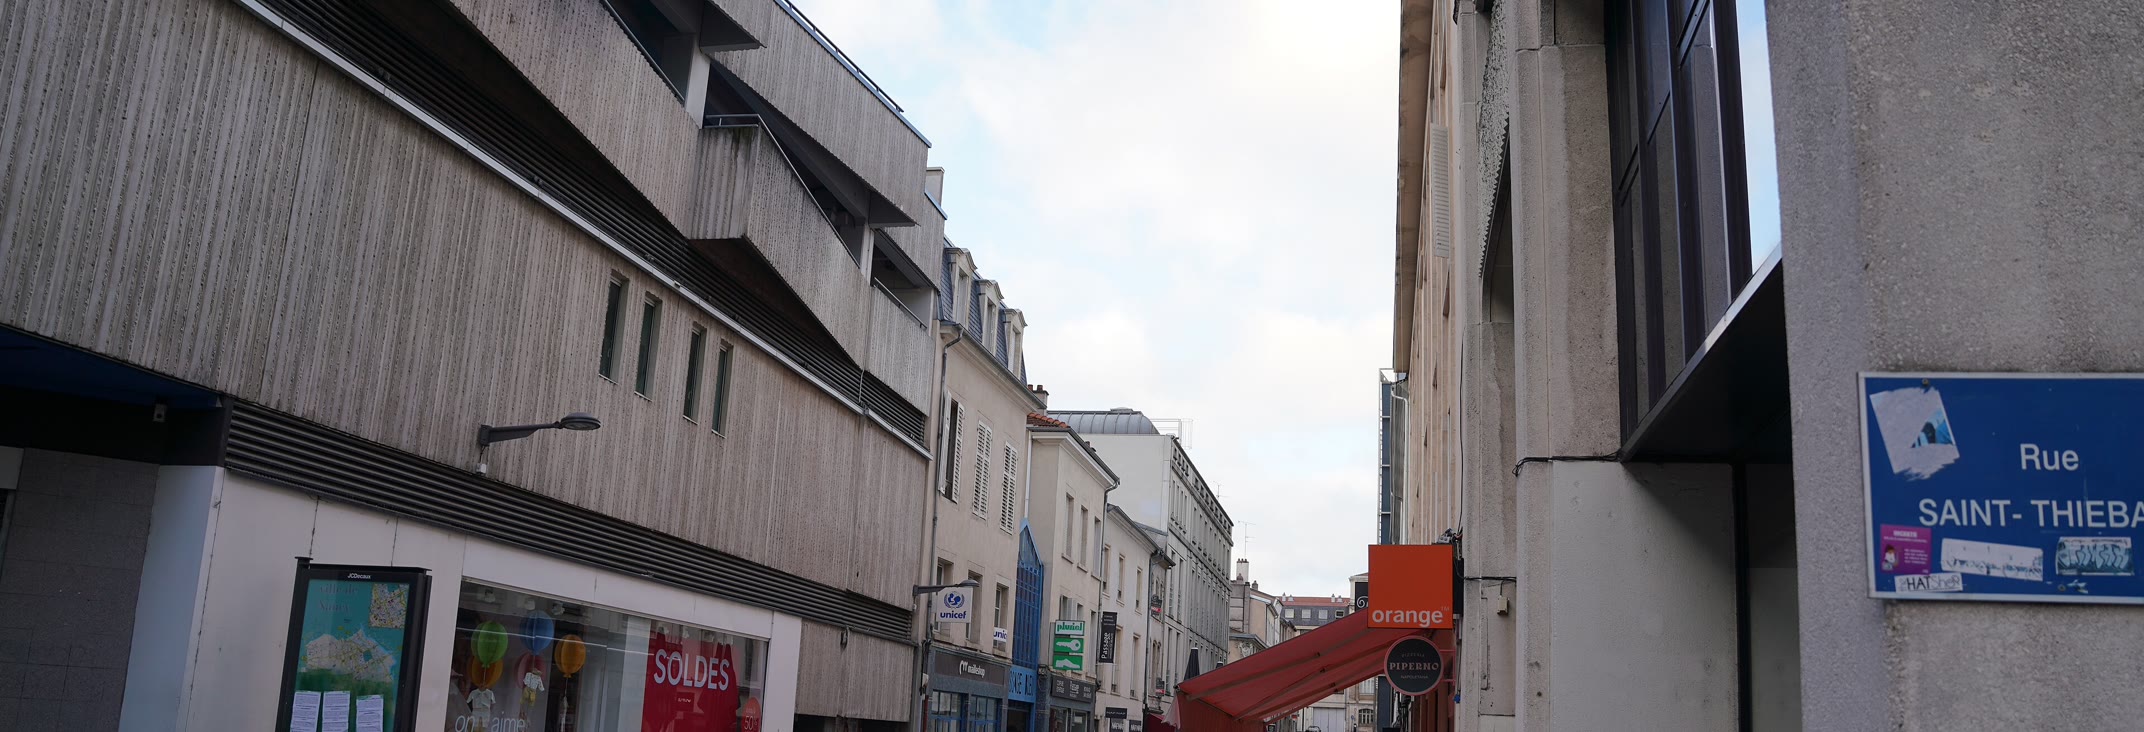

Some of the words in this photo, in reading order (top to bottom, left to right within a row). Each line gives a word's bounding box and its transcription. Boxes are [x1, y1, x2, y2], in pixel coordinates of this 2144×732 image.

[2020, 443, 2080, 471] Rue
[1918, 498, 2023, 527] SAINT-
[347, 573, 371, 581] JCDecaux
[940, 610, 967, 620] unicef
[1372, 609, 1443, 628] orange
[653, 648, 729, 690] SOLDES
[1389, 662, 1439, 671] PIPERNO
[455, 715, 476, 732] on
[491, 711, 526, 732] aime
